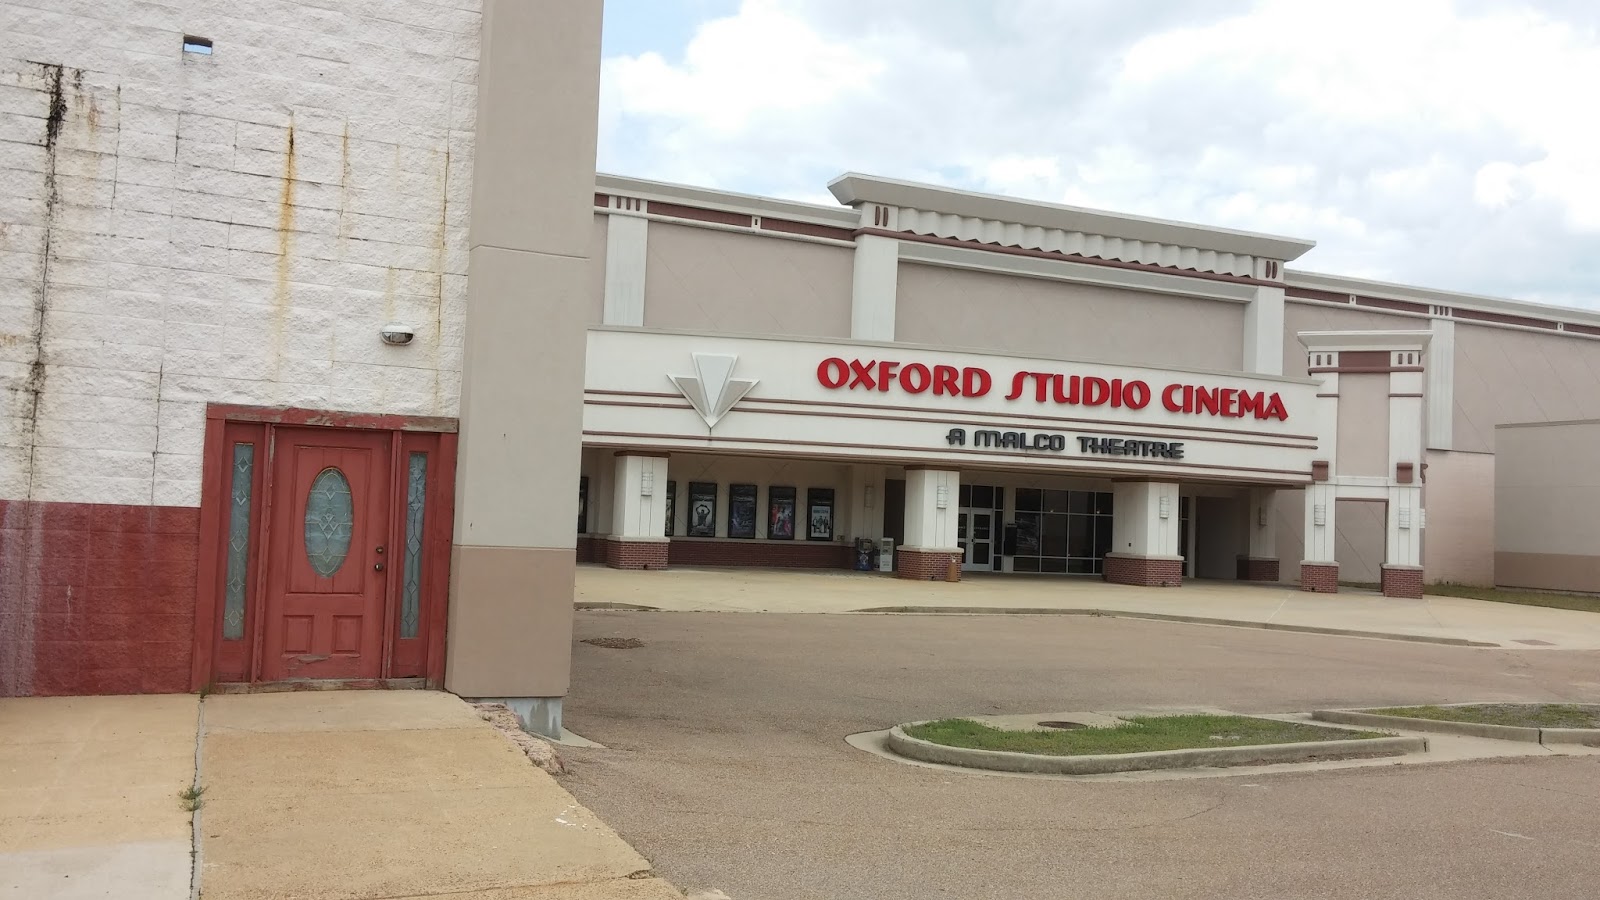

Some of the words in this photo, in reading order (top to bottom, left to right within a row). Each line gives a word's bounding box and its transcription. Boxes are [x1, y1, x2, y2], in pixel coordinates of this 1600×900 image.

[816, 357, 993, 398] OXFORD
[1006, 371, 1152, 410] STUDIO
[1161, 383, 1289, 421] CINEMA
[946, 428, 966, 447] A
[974, 430, 1066, 452] MALCO
[1077, 436, 1186, 460] THEATRE
